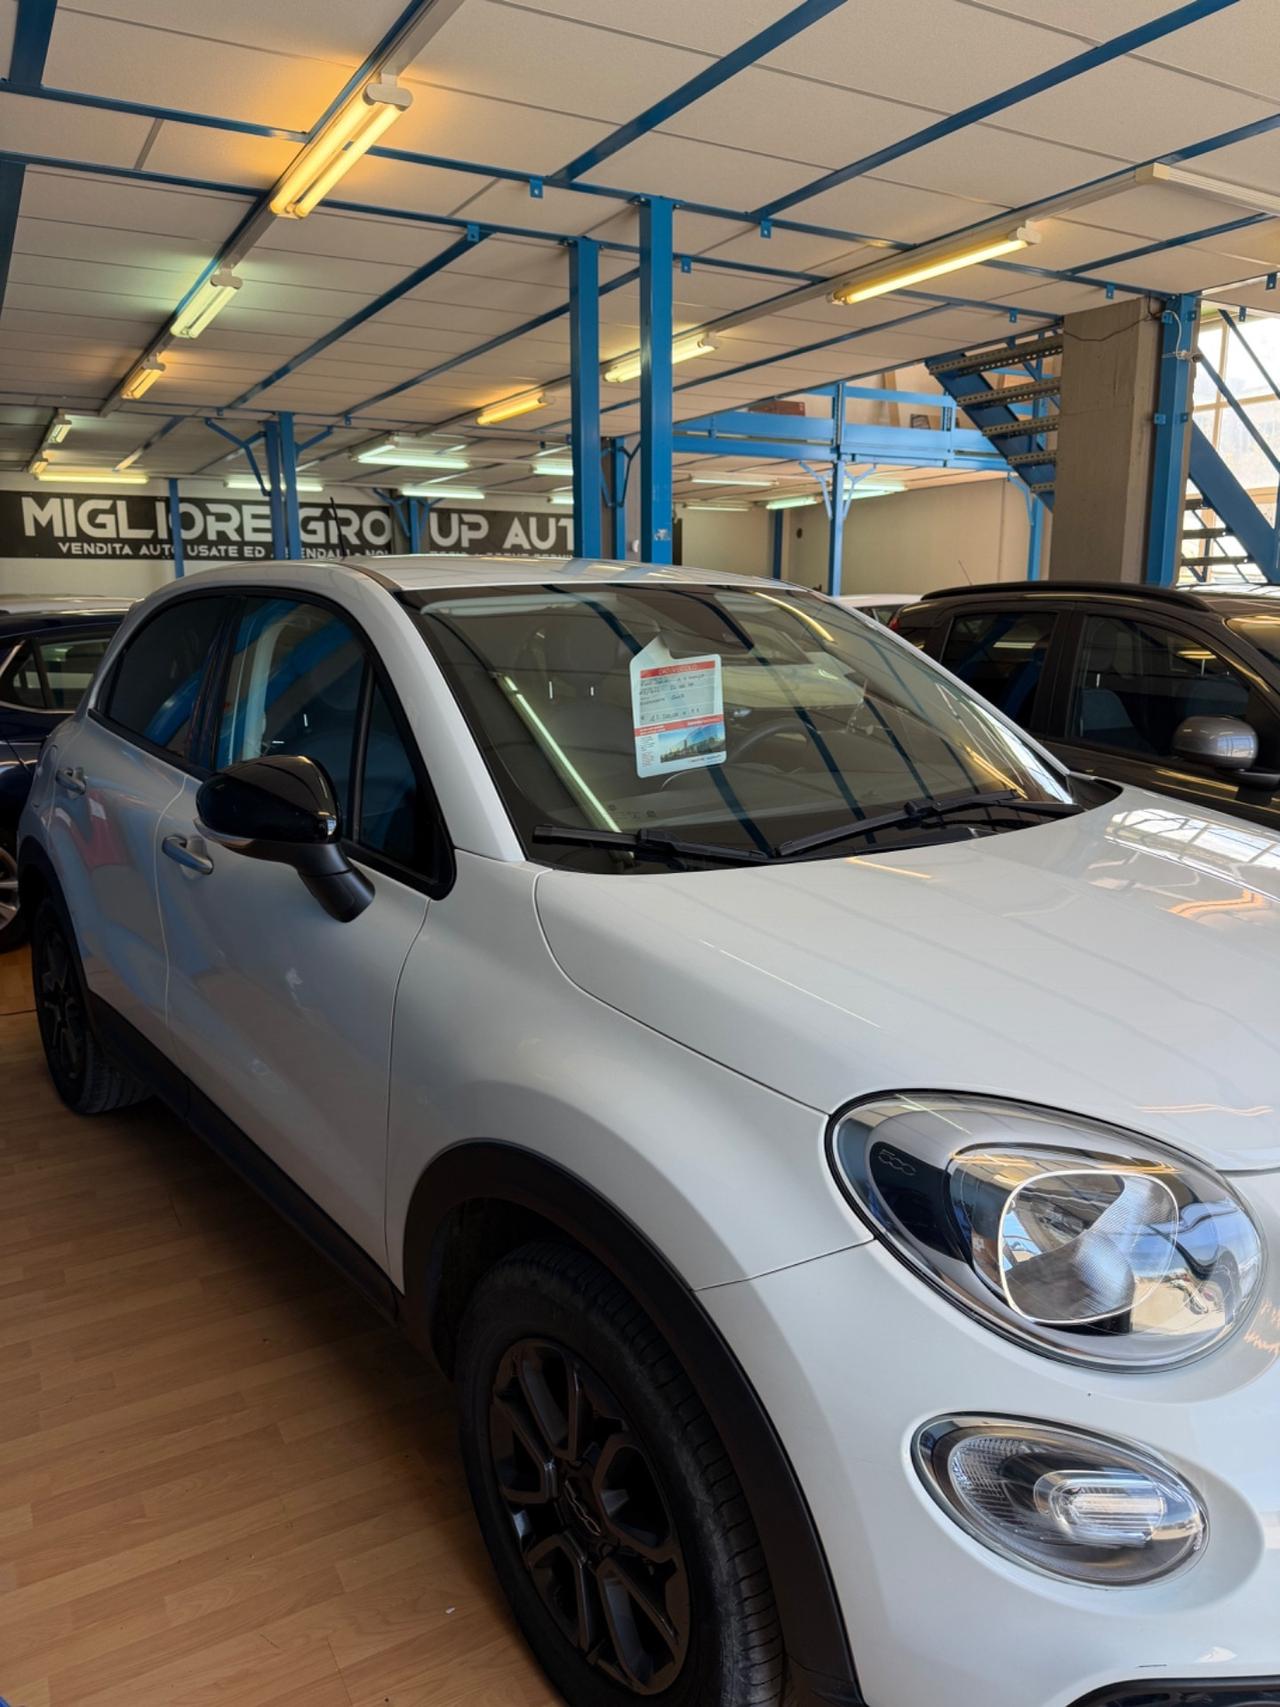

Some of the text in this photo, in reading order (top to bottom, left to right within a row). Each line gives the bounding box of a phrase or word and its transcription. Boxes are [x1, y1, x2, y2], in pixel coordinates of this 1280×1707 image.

[21, 496, 272, 543] MIGLIORE
[429, 511, 489, 548] UP
[58, 542, 133, 556] VENDITA
[139, 544, 175, 557] AUT
[186, 544, 239, 558] USATE
[243, 546, 266, 559] ED
